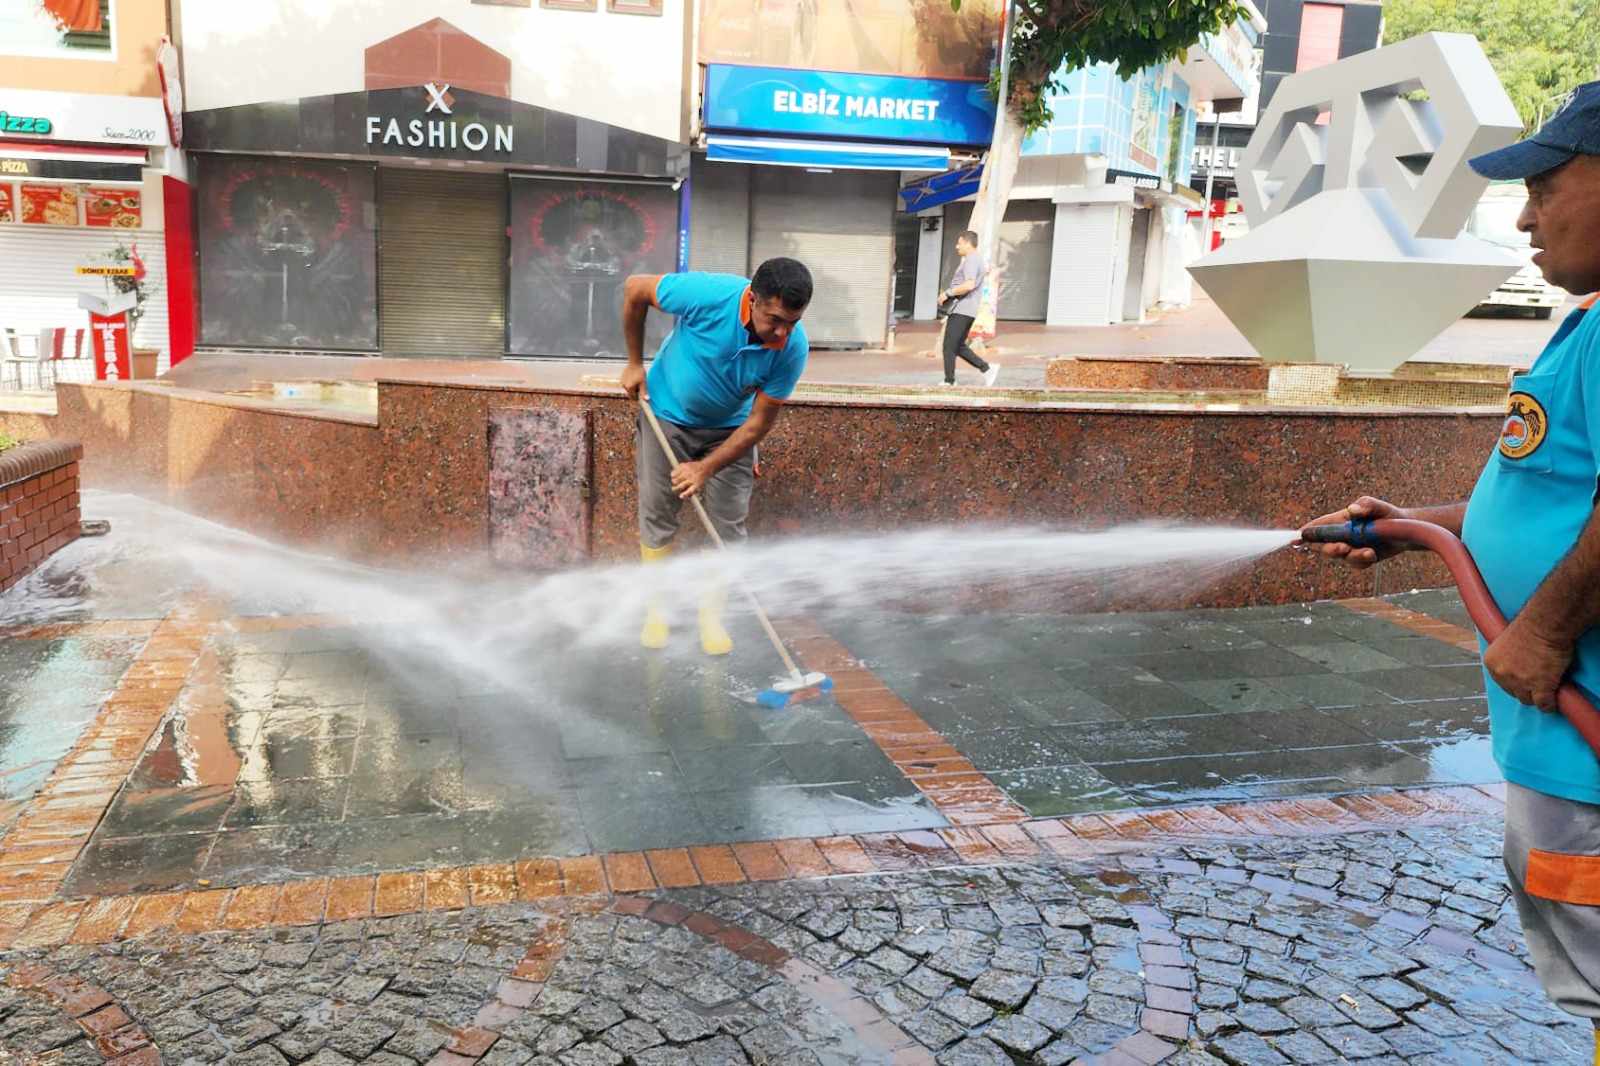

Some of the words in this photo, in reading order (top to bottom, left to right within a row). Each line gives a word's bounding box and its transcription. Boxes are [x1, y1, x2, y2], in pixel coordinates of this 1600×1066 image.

[424, 83, 452, 114] X
[773, 88, 839, 116] ELBİZ
[845, 96, 939, 121] MARKET
[0, 110, 52, 134] izza
[126, 128, 156, 142] 2000
[366, 116, 513, 152] FASHION
